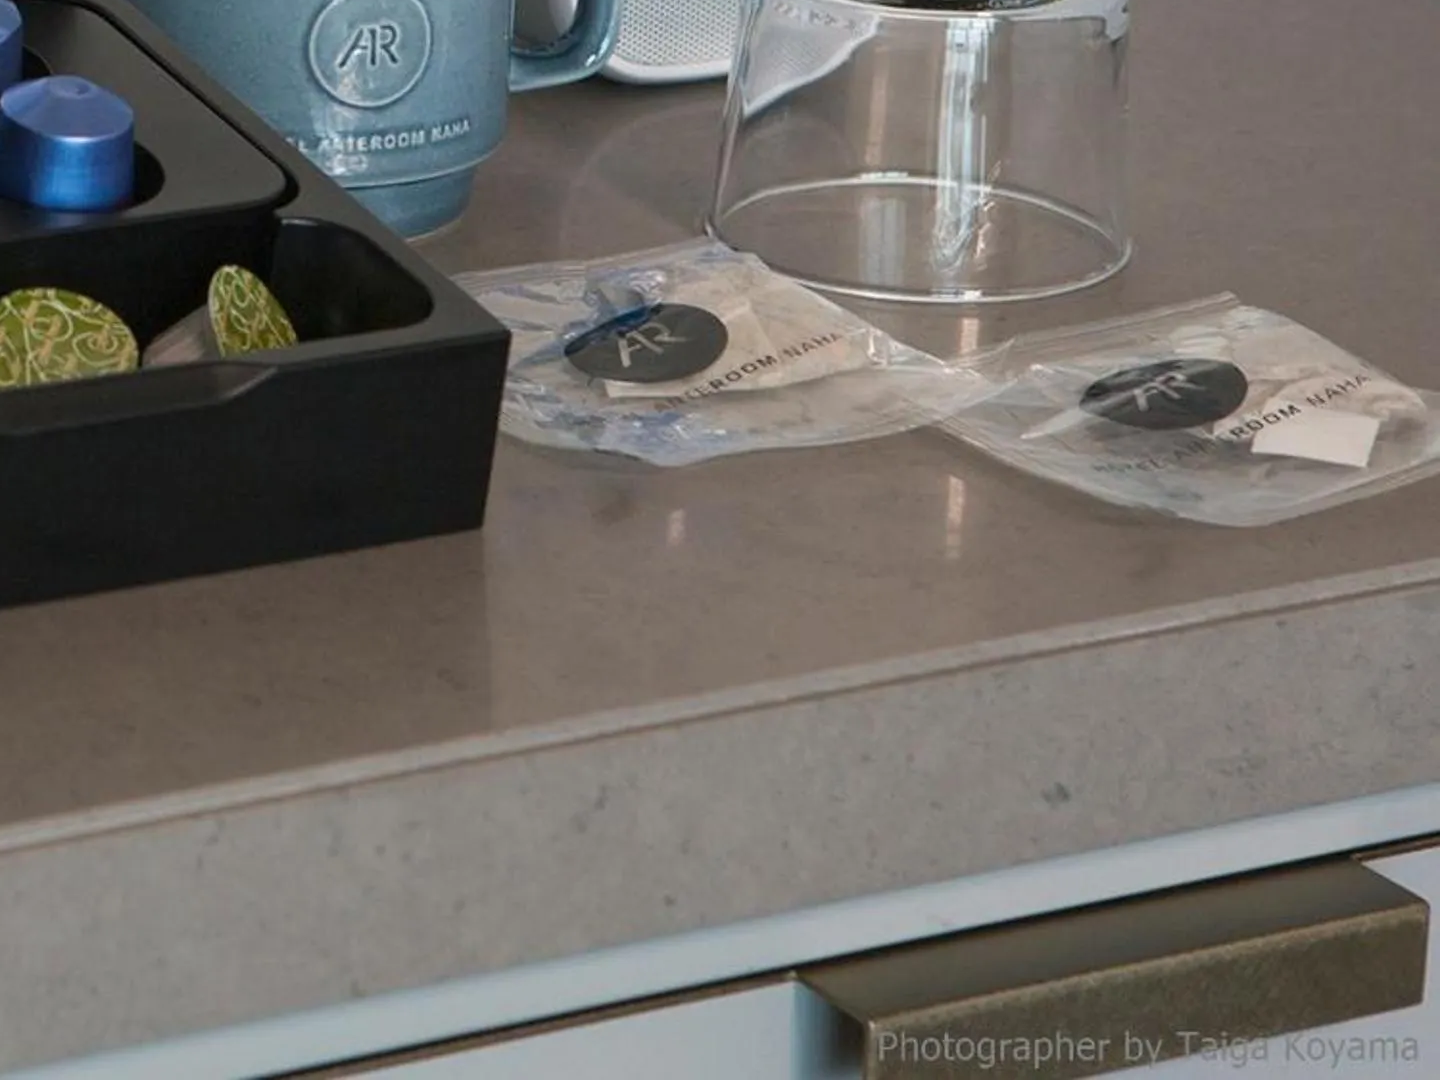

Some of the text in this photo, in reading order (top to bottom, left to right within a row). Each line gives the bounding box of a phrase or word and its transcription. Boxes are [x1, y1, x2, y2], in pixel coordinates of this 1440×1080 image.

[336, 22, 400, 70] AR
[617, 321, 692, 368] AR
[1307, 374, 1370, 408] NAHA
